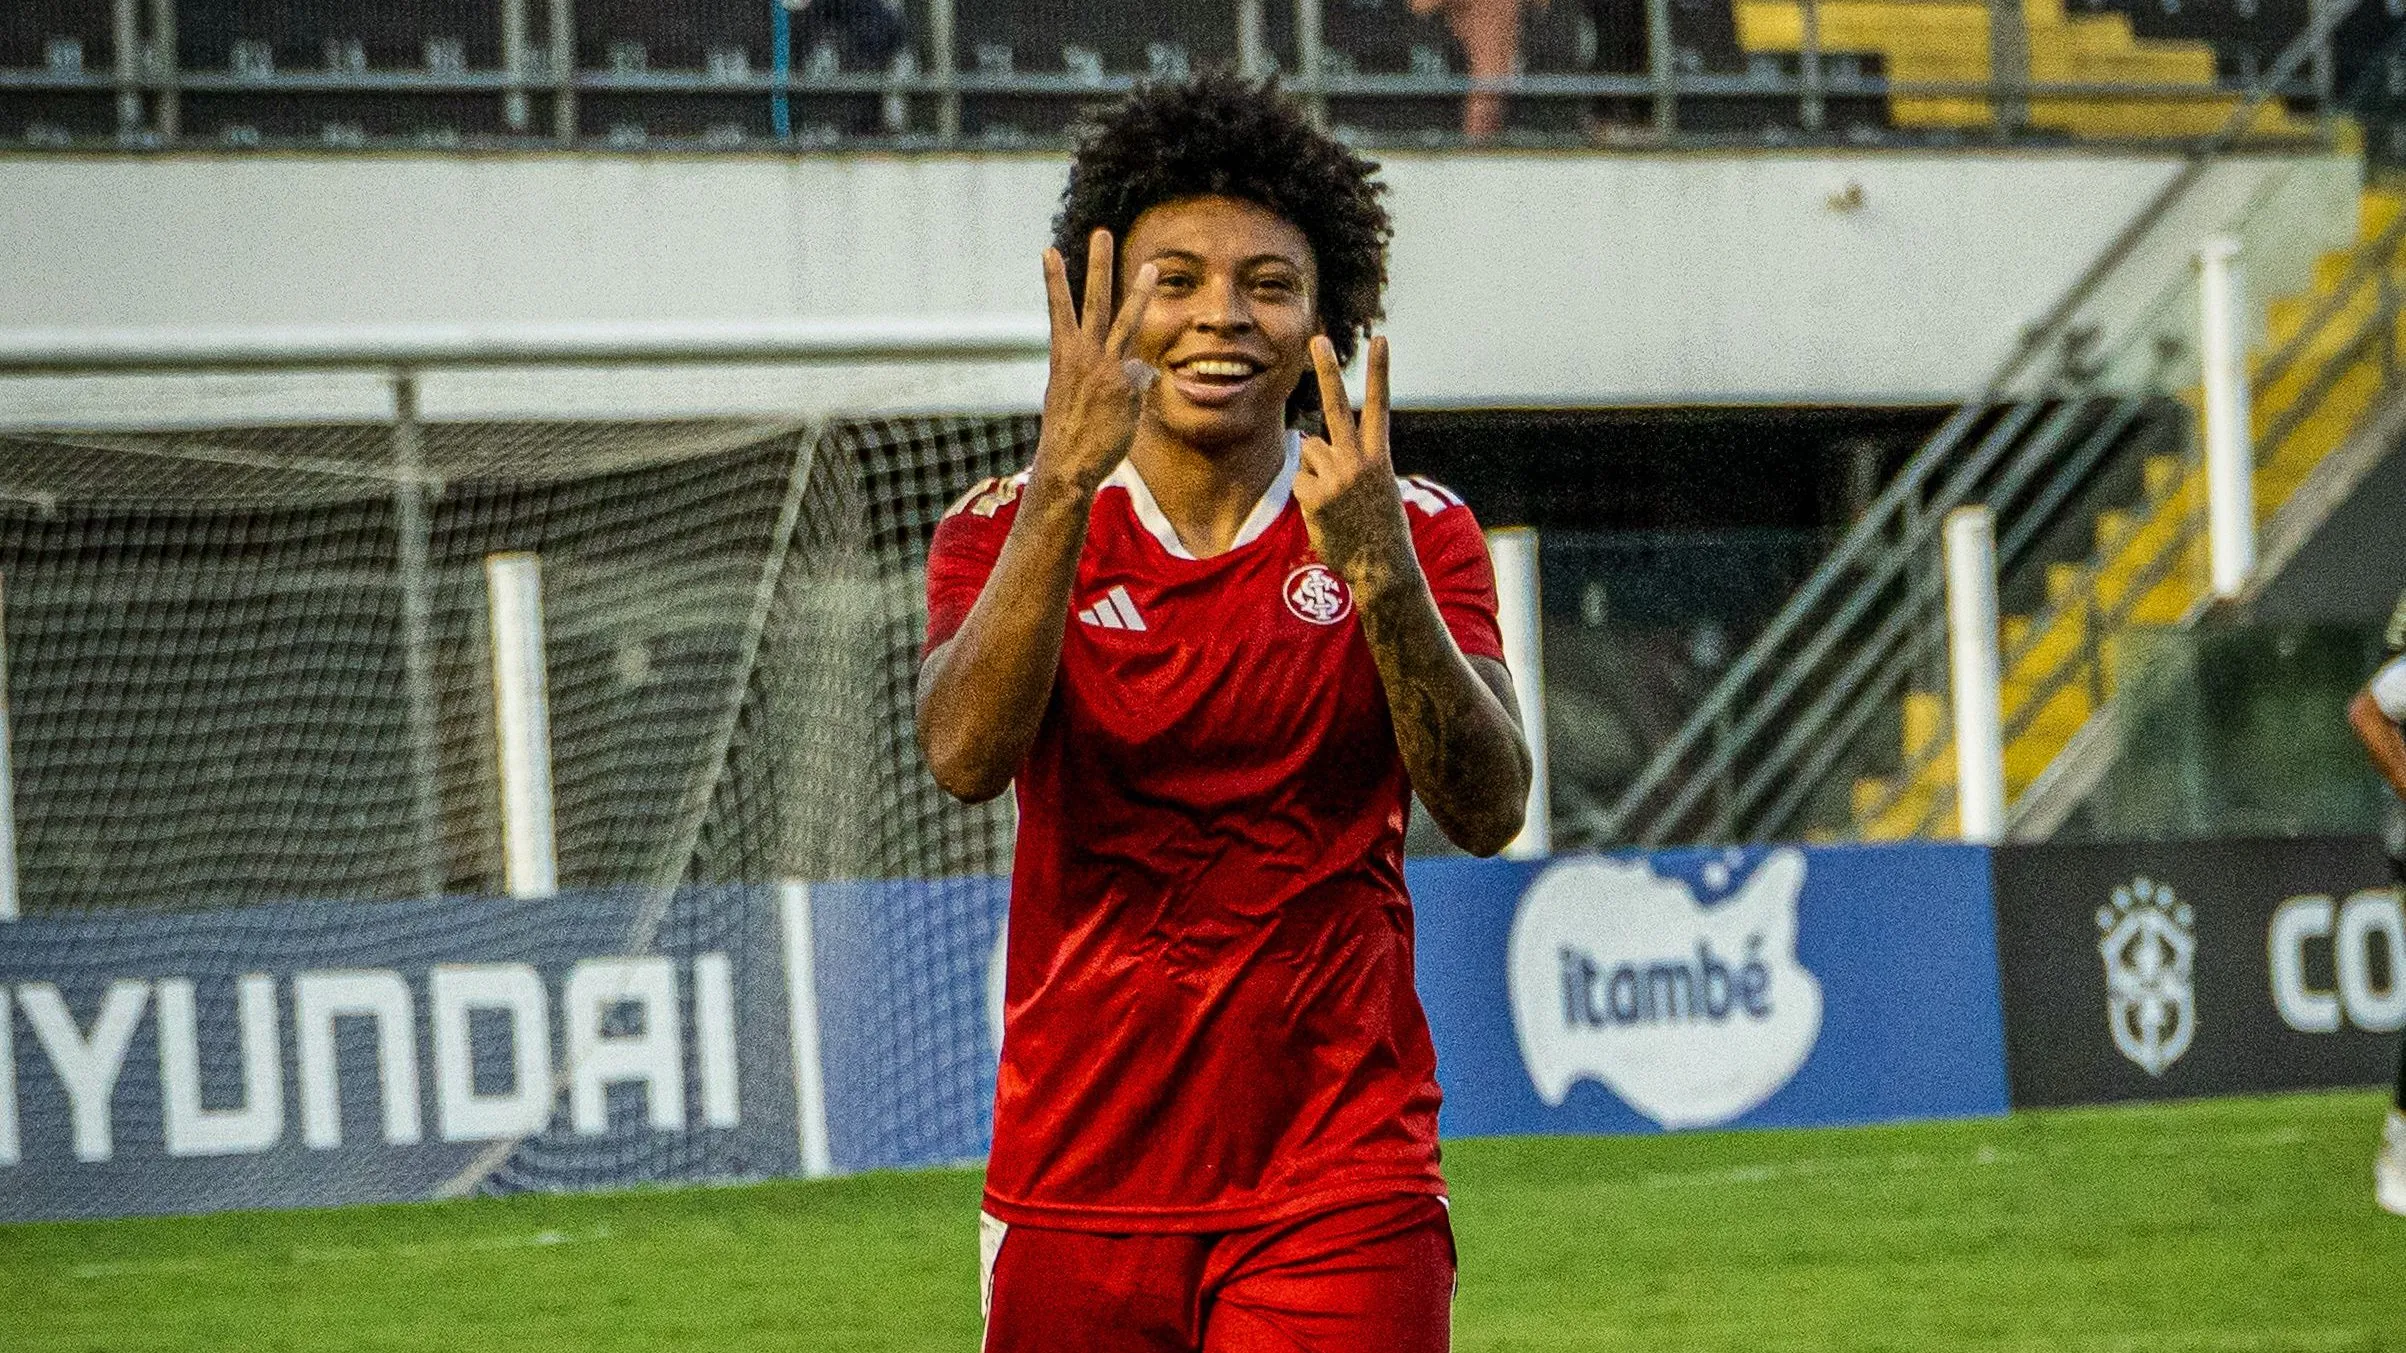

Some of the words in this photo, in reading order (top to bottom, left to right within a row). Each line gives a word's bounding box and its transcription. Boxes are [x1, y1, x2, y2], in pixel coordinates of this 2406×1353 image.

[1557, 932, 1773, 1031] itambé
[2267, 890, 2406, 1033] CO
[0, 952, 741, 1166] YUNDAI
